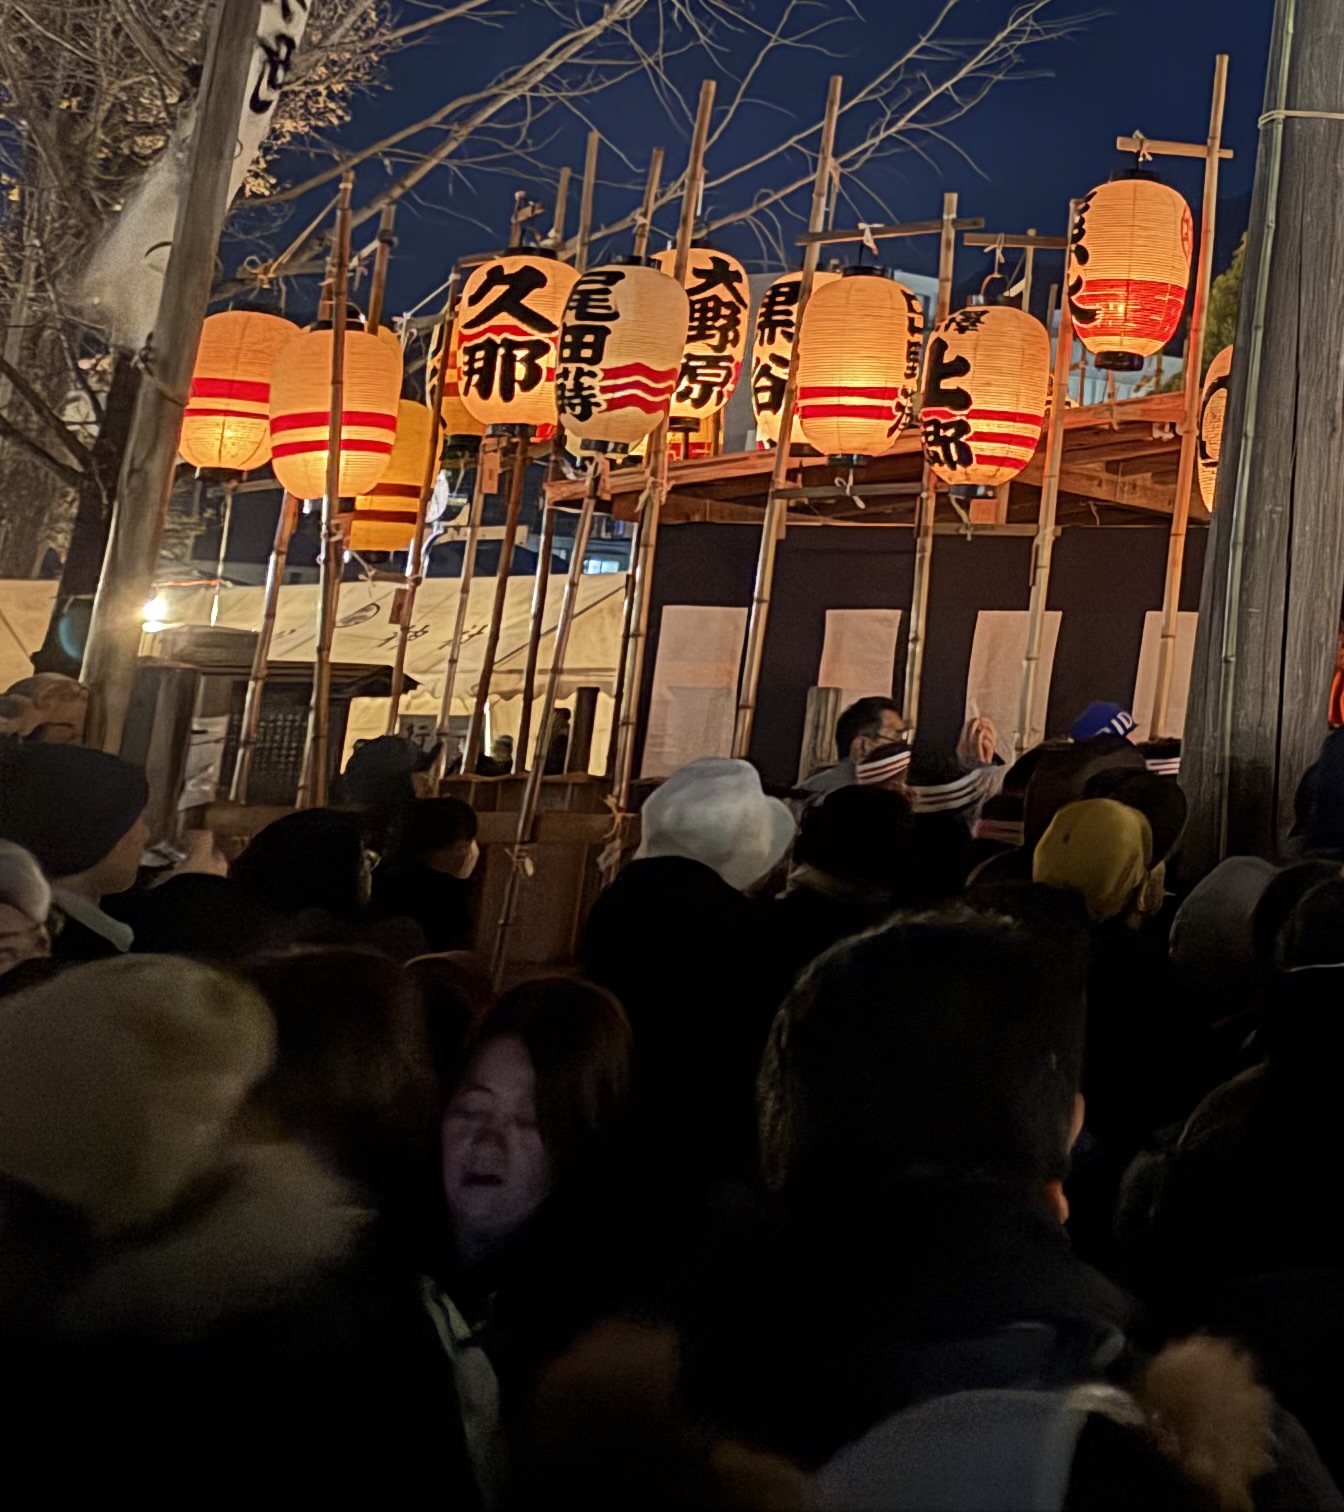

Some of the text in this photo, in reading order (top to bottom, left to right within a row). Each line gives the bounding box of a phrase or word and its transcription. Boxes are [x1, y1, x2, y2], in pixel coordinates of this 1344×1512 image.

[461, 264, 559, 403] 久那
[674, 256, 748, 409] 大野原
